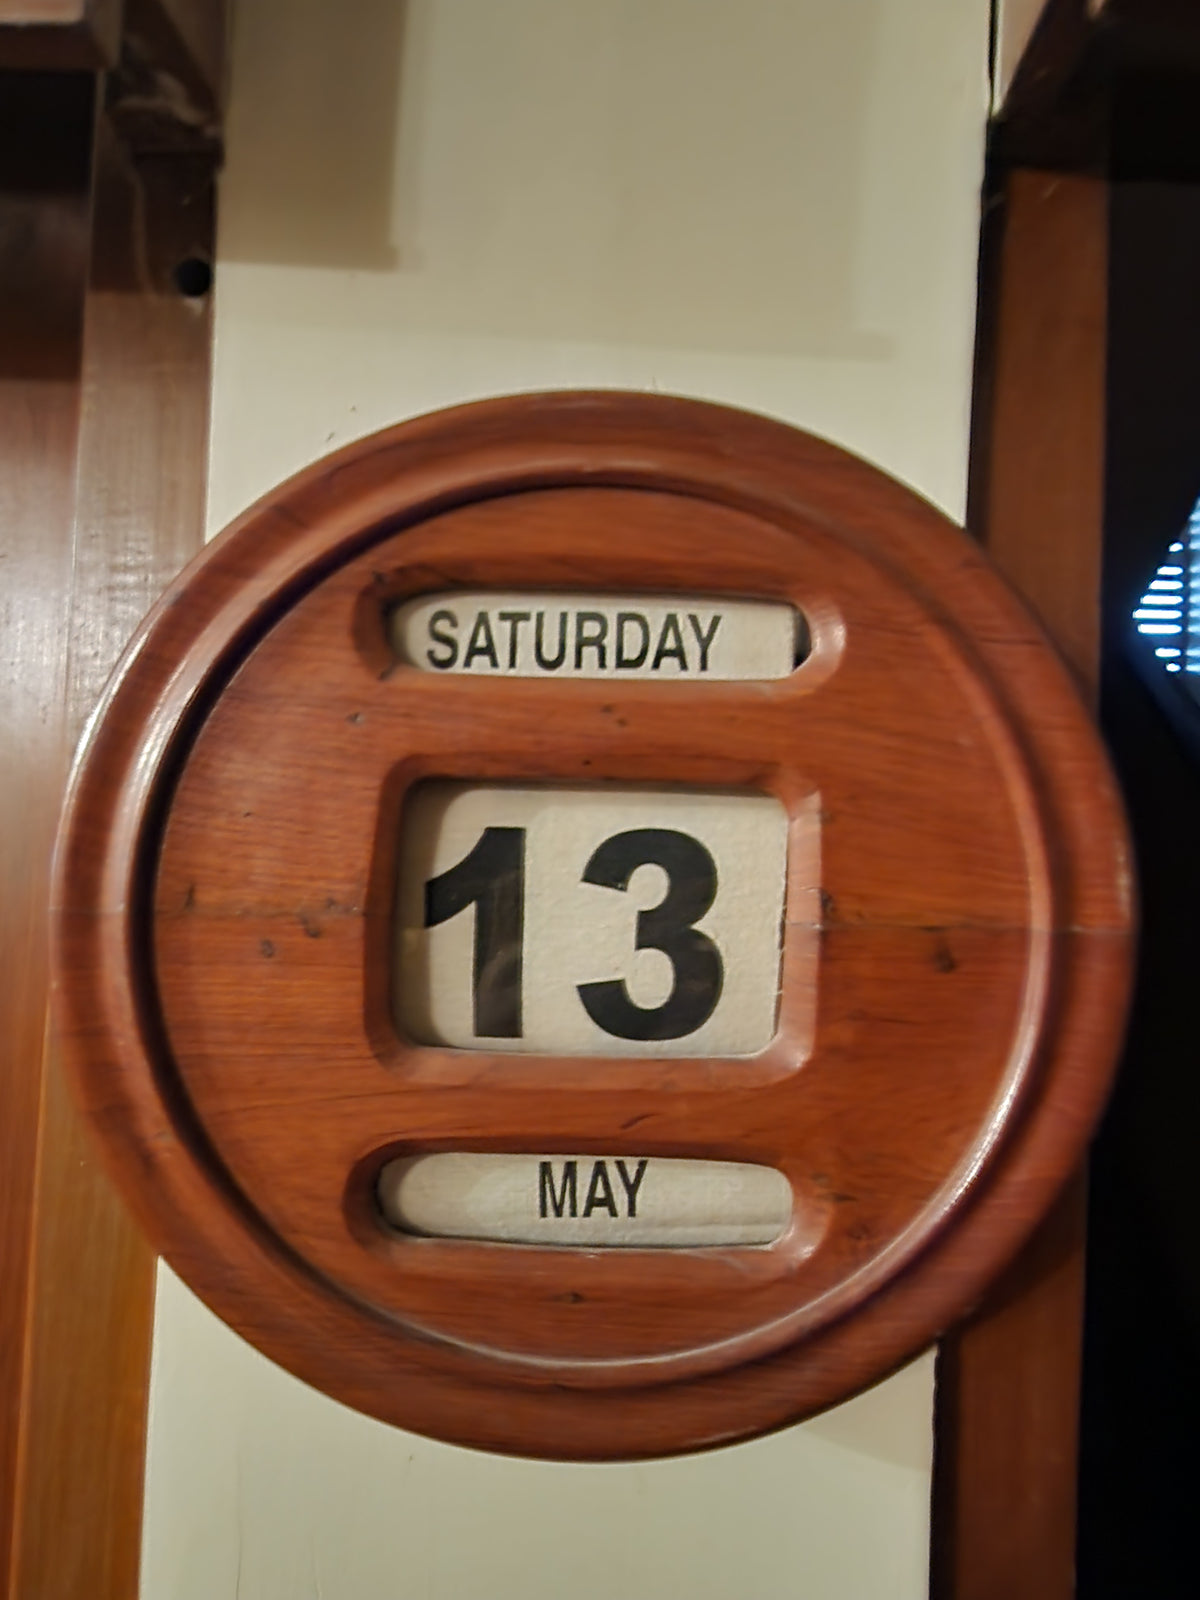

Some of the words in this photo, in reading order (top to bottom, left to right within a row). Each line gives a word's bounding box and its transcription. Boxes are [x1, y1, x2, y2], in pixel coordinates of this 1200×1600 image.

[427, 610, 721, 672] SATURDAY
[424, 826, 724, 1042] 13
[538, 1159, 649, 1219] MAY
